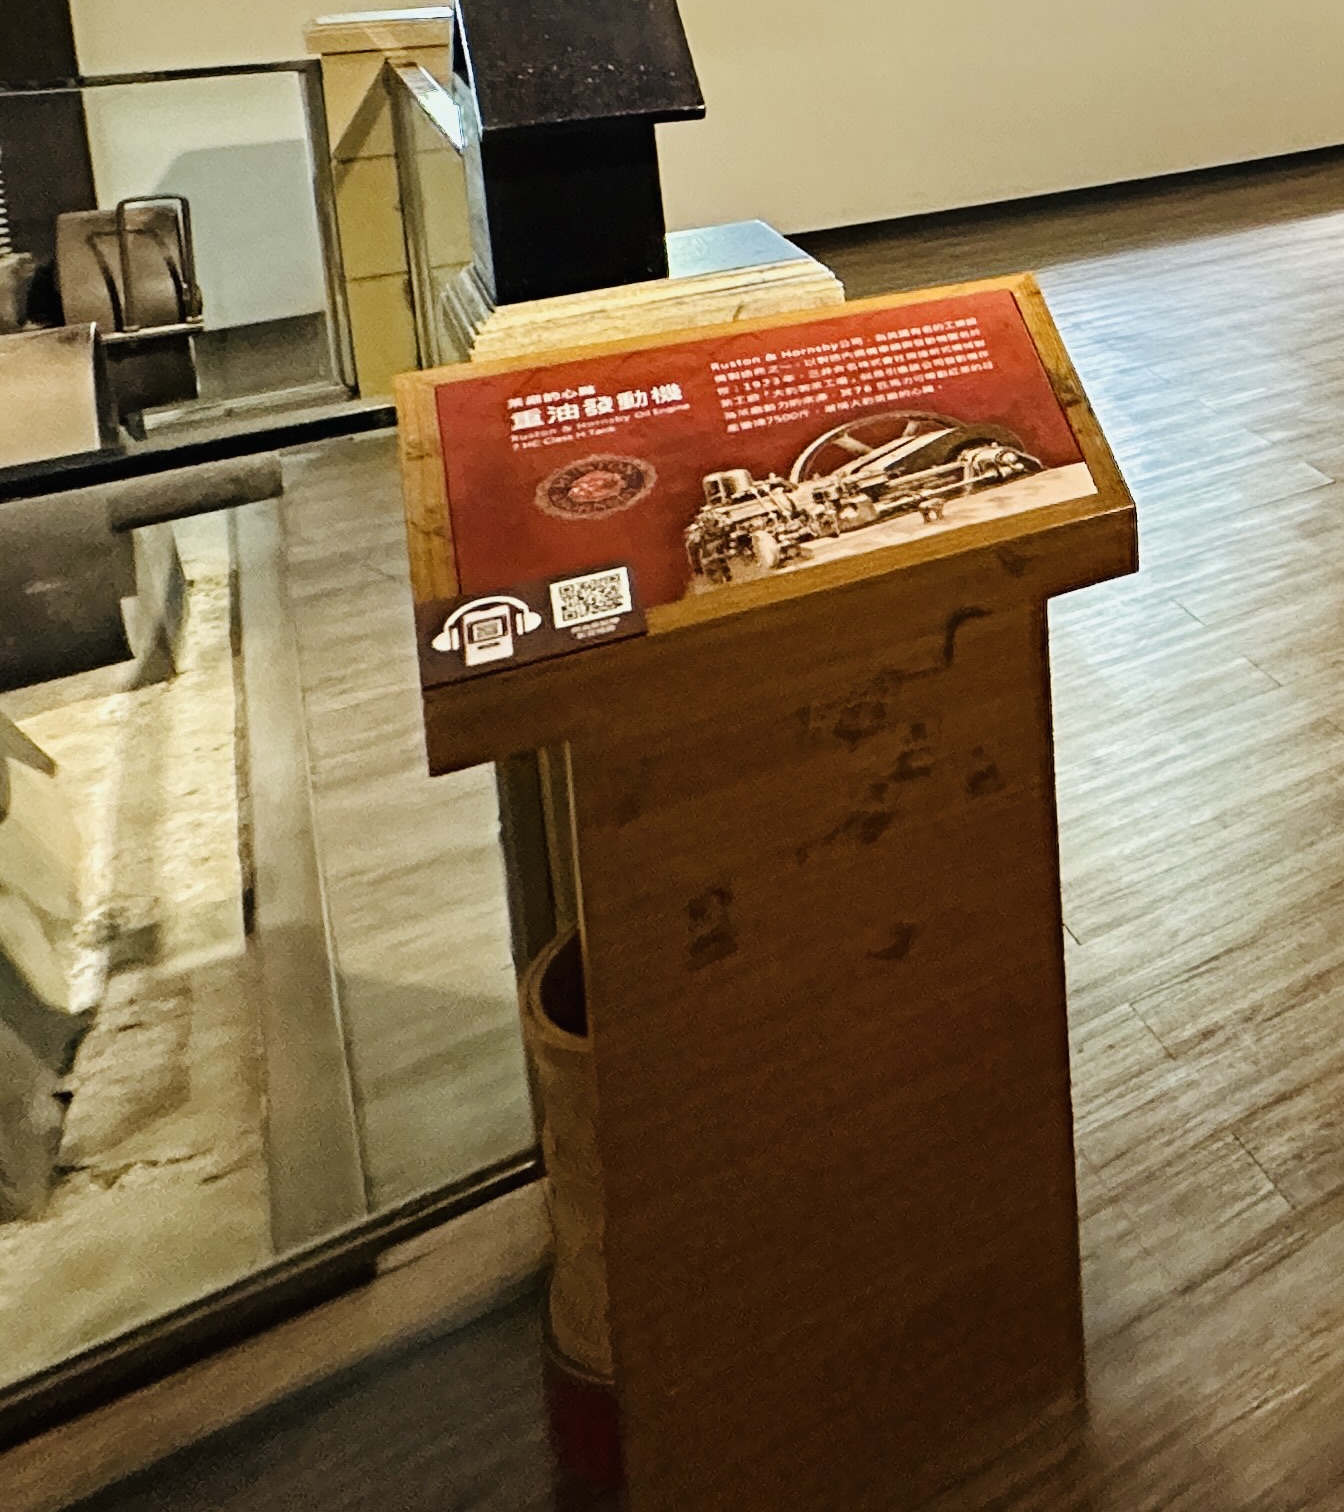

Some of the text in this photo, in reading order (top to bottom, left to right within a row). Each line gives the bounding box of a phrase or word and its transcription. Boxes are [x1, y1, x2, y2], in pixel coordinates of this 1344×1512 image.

[710, 356, 761, 371] Ruston
[765, 353, 777, 362] &
[511, 383, 683, 431] 重油發動機
[511, 428, 557, 443] Ruston
[576, 414, 631, 430] Hornsby
